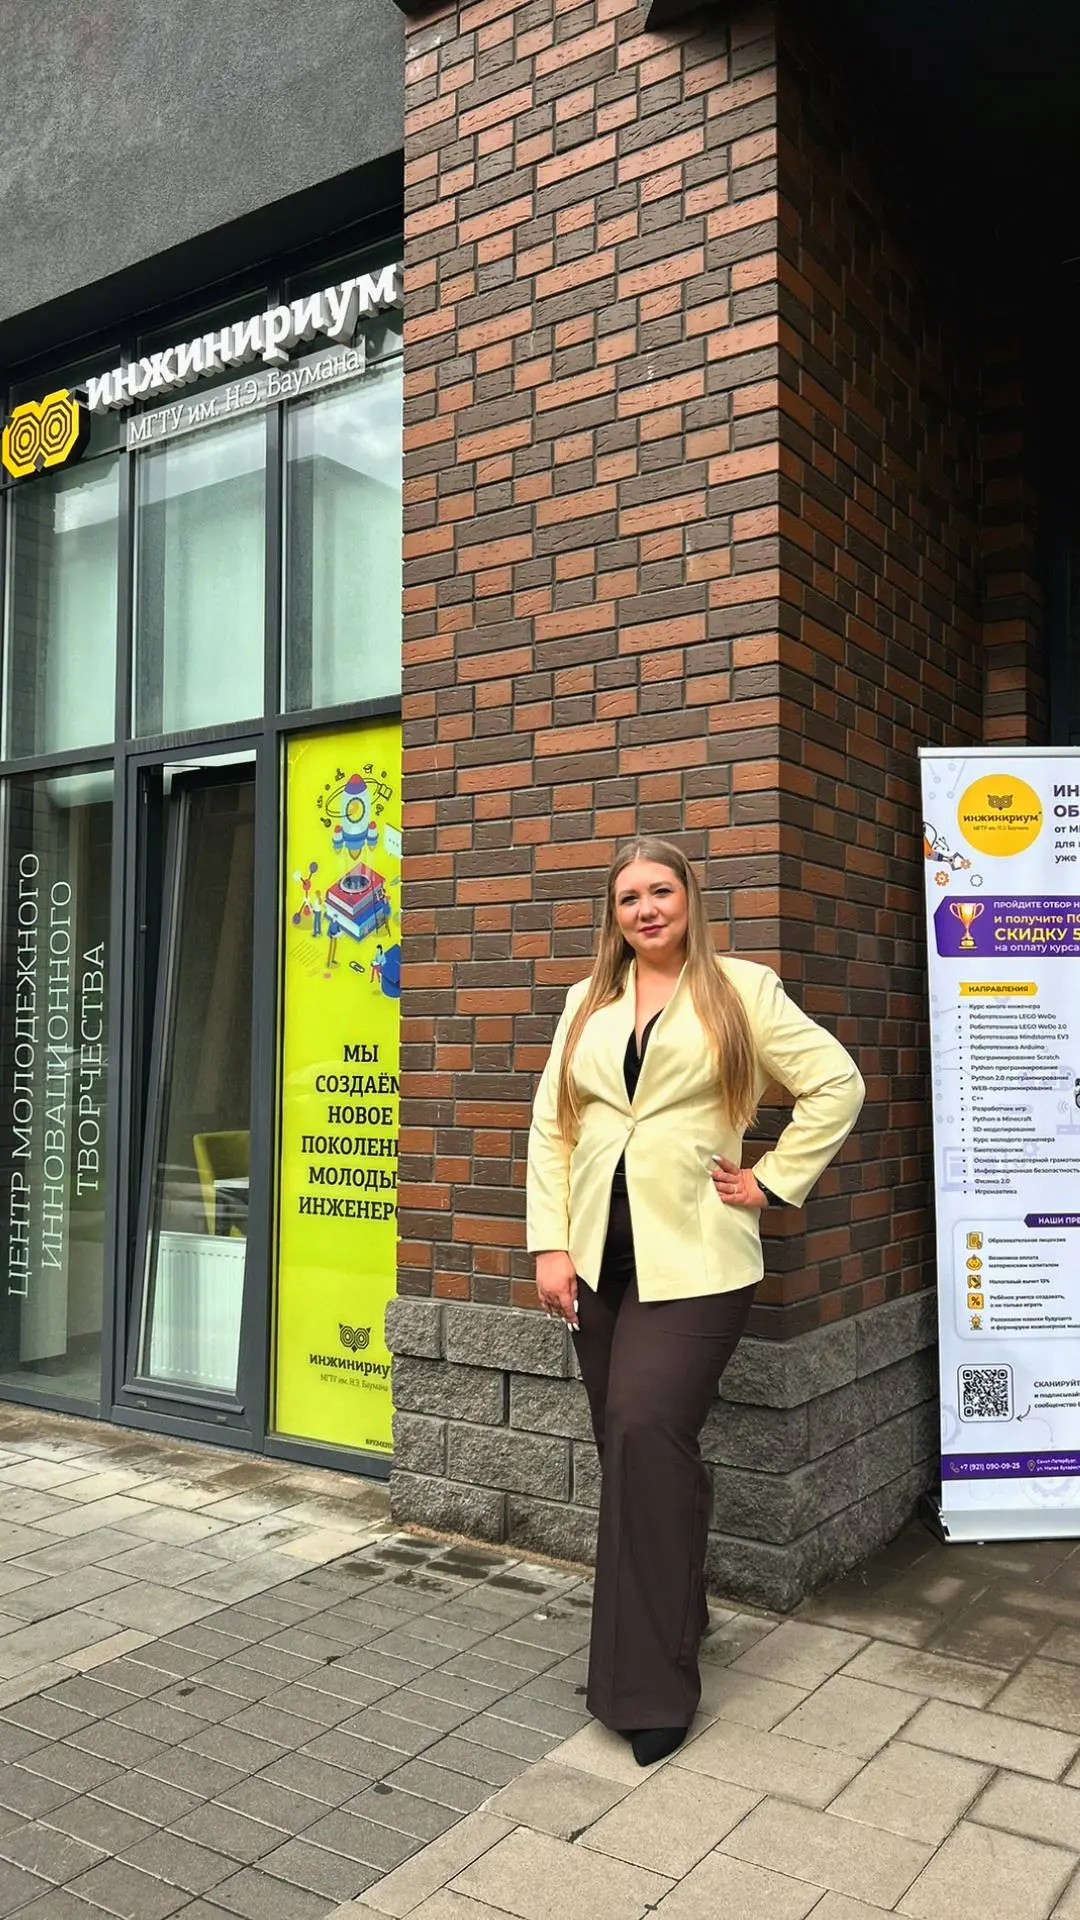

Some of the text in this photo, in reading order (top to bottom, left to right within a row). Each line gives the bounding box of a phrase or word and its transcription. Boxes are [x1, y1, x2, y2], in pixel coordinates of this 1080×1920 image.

[86, 263, 397, 411] инжинириум
[130, 350, 360, 445] МГТУ им. Н.Э. Баумана
[1053, 784, 1080, 797] ИН
[1053, 804, 1080, 818] ОБ
[963, 815, 1039, 824] инжинириум
[1054, 825, 1080, 834] от М
[1054, 841, 1075, 849] для
[1055, 855, 1077, 864] уже
[993, 900, 1042, 909] ПРОЙДИТЕ
[1043, 900, 1072, 909] ОТБОР
[994, 915, 1002, 923] и
[1005, 915, 1063, 925] получите
[994, 927, 1068, 943] СКИДКУ
[1010, 944, 1047, 953] оплату
[1050, 944, 1080, 953] курса
[343, 1045, 379, 1062] МЫ
[8, 854, 40, 1297] ЦЕНТР МОЛОДЕЖНОГО
[42, 881, 71, 1270] ИННОВАЦИОННОГО
[77, 942, 105, 1195] ТВОРЧЕСТВА
[327, 1106, 393, 1125] НОВОЕ
[298, 1197, 397, 1220] ИНЖЕНЕР
[309, 1353, 391, 1379] инжинириу
